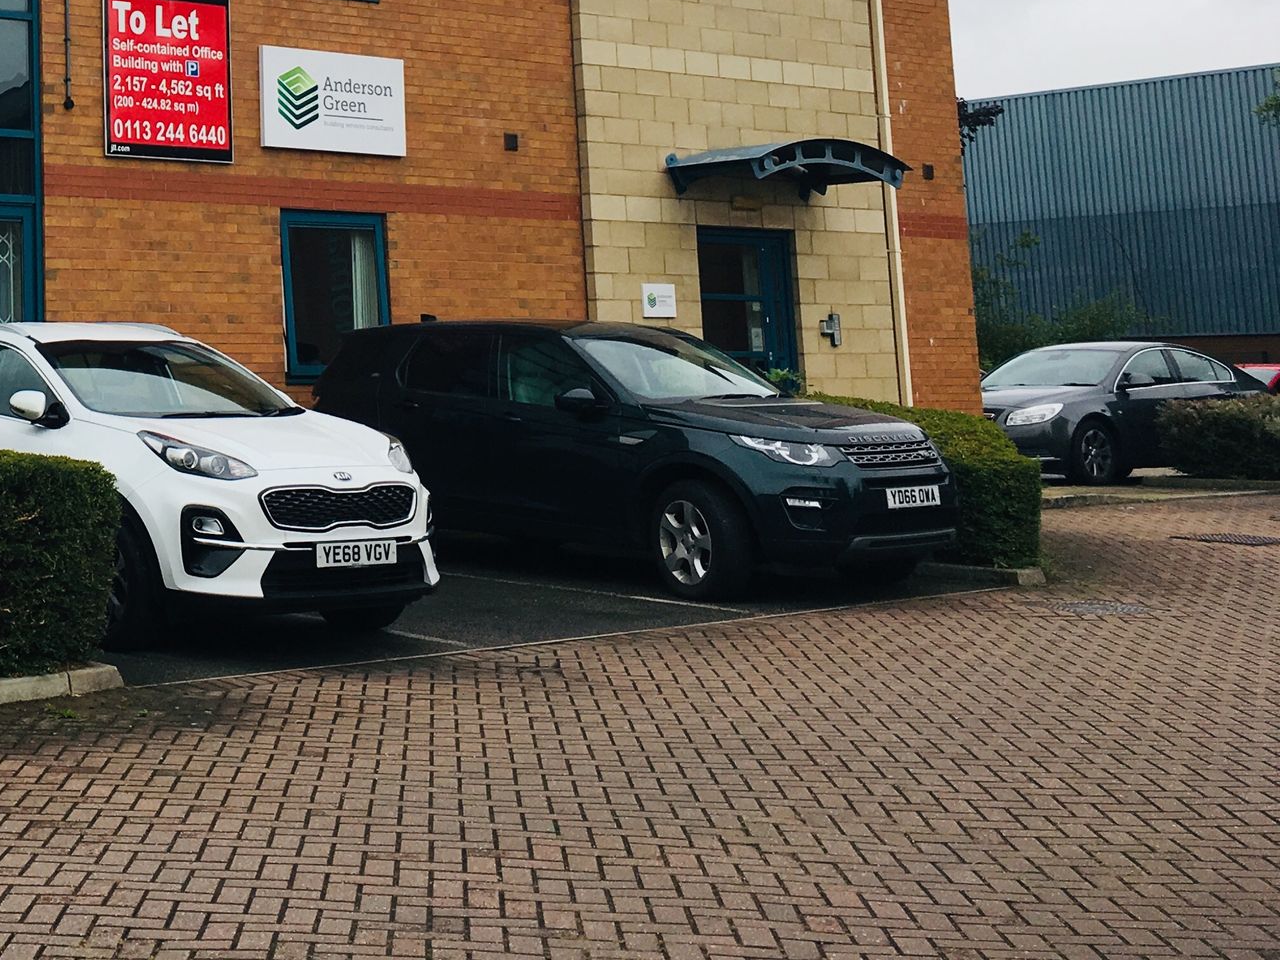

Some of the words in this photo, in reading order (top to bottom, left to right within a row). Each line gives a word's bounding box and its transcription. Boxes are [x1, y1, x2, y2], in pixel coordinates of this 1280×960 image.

[112, 0, 146, 35] To
[155, 5, 199, 40] Let
[112, 38, 189, 57] Self-contained
[192, 45, 223, 60] Office
[113, 55, 158, 73] Building
[161, 60, 183, 73] with
[113, 74, 147, 93] 2,157
[158, 78, 193, 96] 4,562
[195, 85, 211, 101] sq
[214, 83, 224, 98] ft
[323, 76, 393, 97] Anderson
[113, 95, 134, 109] (200
[141, 97, 171, 111] 424.82
[174, 102, 185, 114] sq
[187, 101, 199, 115] m)
[323, 95, 367, 113] Green
[114, 118, 151, 140] 0113
[156, 122, 184, 142] 244
[189, 124, 226, 145] 6440
[848, 433, 919, 443] DISCOVERY
[334, 472, 351, 480] KIA
[890, 488, 917, 505] YD66
[918, 488, 937, 504] OWA
[323, 544, 360, 563] YE68
[365, 543, 391, 561] VGV
